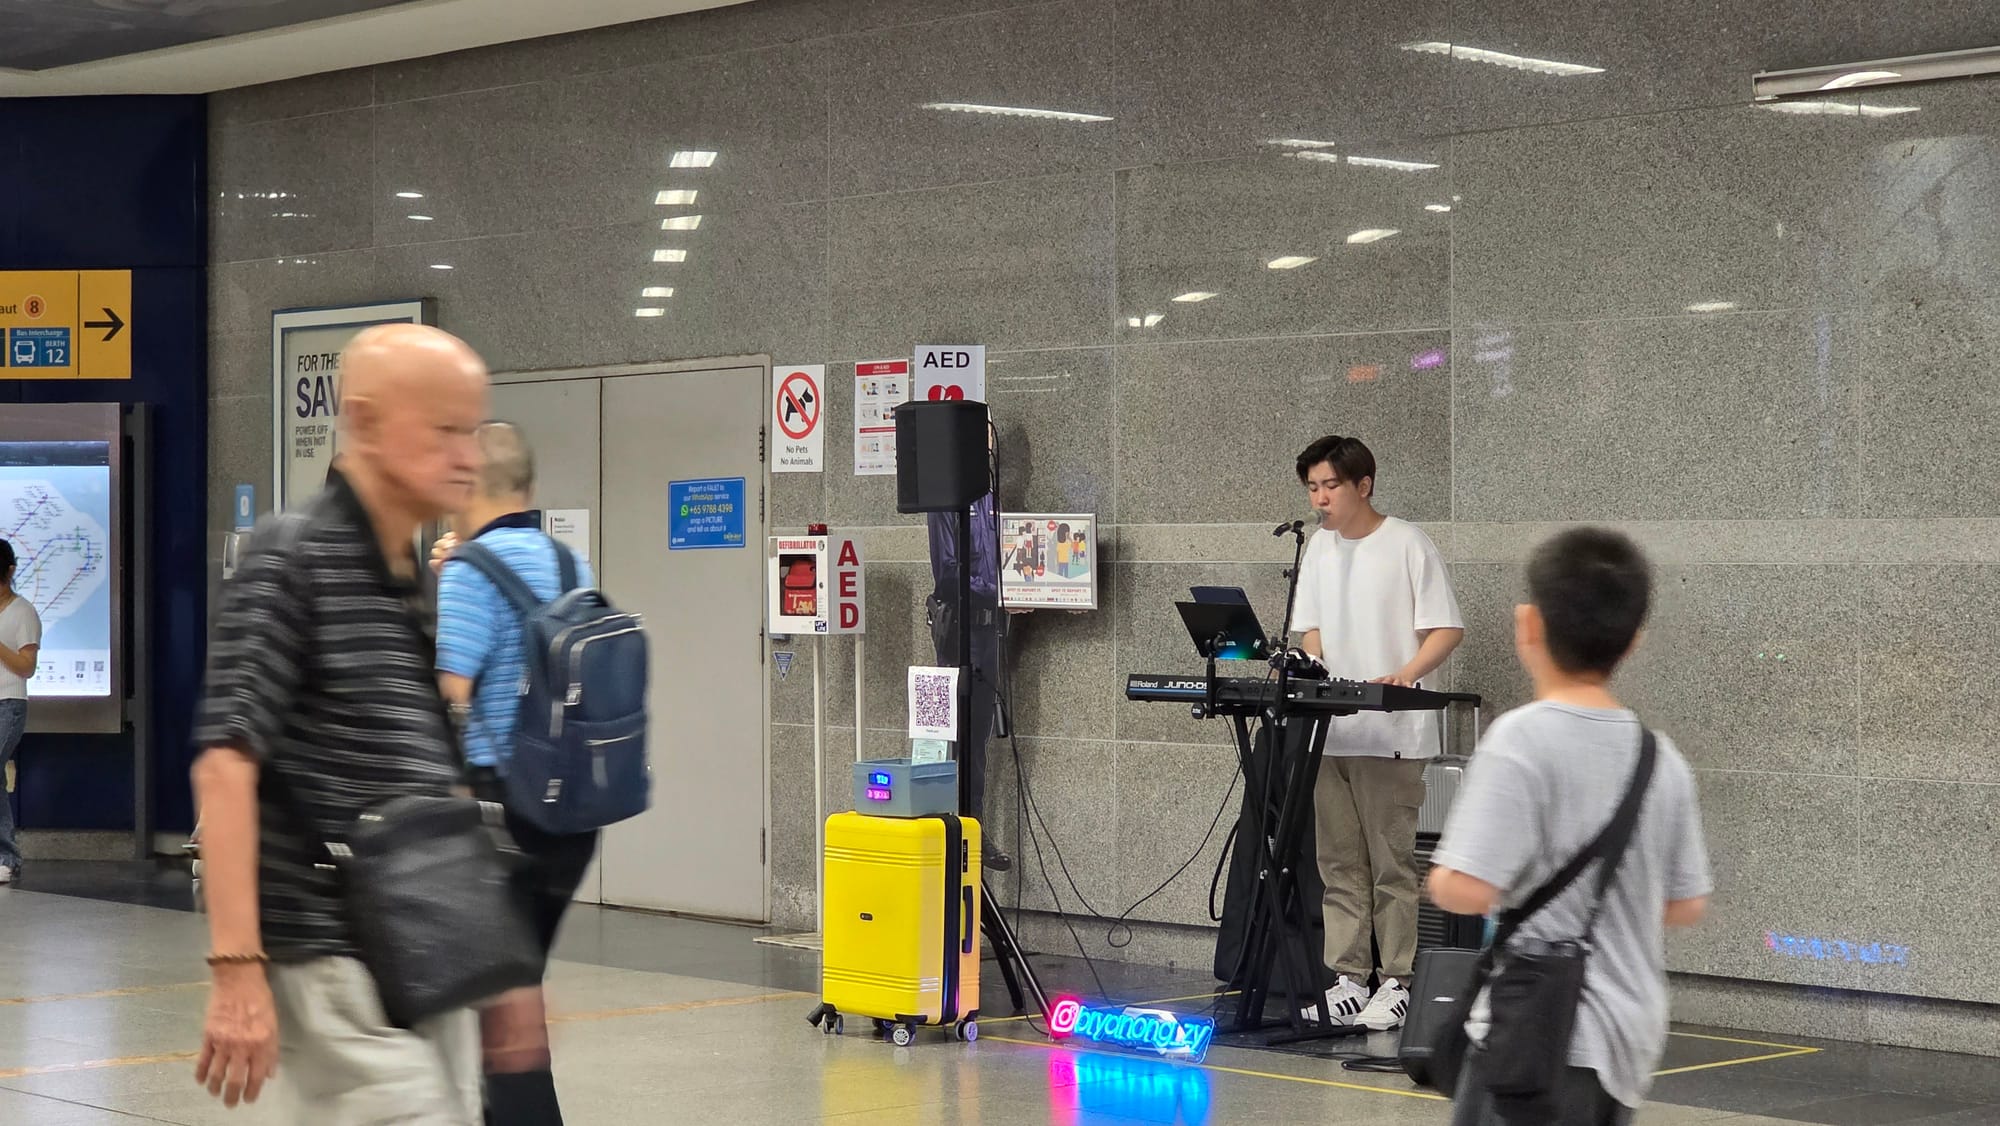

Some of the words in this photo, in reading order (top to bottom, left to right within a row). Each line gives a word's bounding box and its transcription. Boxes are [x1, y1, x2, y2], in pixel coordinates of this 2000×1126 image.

[0, 304, 17, 314] aut
[30, 300, 39, 314] 8
[46, 349, 64, 363] 12
[923, 351, 970, 368] AED
[297, 354, 318, 372] FOR
[296, 375, 343, 418] SAV
[296, 425, 316, 435] POWER
[317, 425, 328, 435] OFF
[296, 437, 312, 447] WHEN
[314, 436, 326, 445] NOT
[296, 448, 302, 458] IN
[303, 448, 315, 458] USE
[790, 457, 813, 465] Animals
[690, 505, 701, 514] +65
[702, 504, 716, 513] 9788
[779, 541, 816, 549] DEFIBRILLATOR
[837, 540, 859, 629] AED
[1137, 680, 1158, 688] Roland
